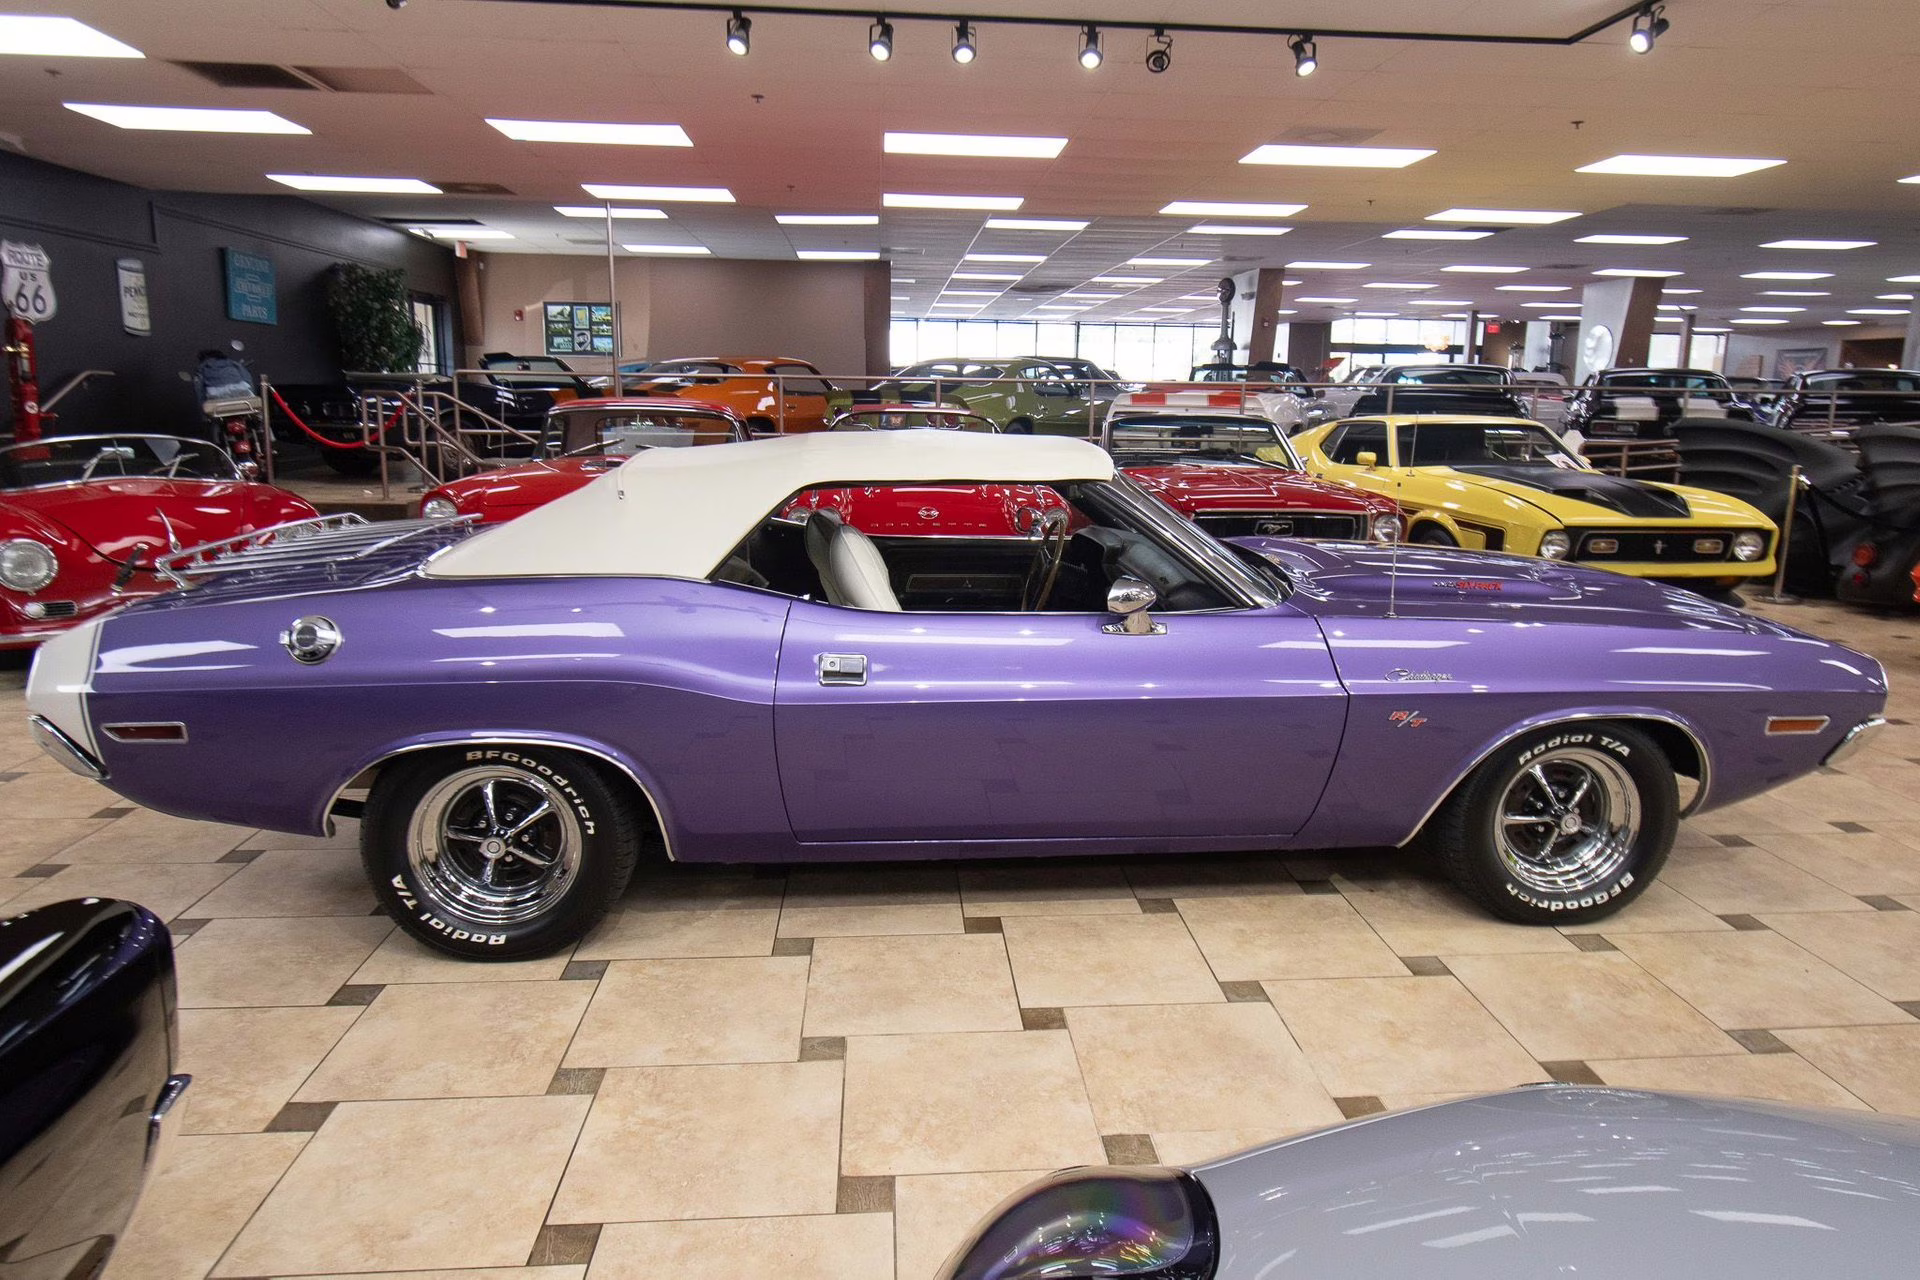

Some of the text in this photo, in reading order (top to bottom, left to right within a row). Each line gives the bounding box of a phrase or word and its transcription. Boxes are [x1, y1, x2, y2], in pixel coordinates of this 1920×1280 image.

[7, 248, 44, 267] ROUTE
[19, 270, 37, 282] US
[16, 283, 47, 315] 66
[1389, 710, 1428, 728] R/T
[1518, 733, 1632, 766] Radial T/A
[466, 750, 595, 836] BFGoodrich
[1506, 872, 1635, 912] BFGoodrich
[391, 873, 507, 946] Radial T/A
